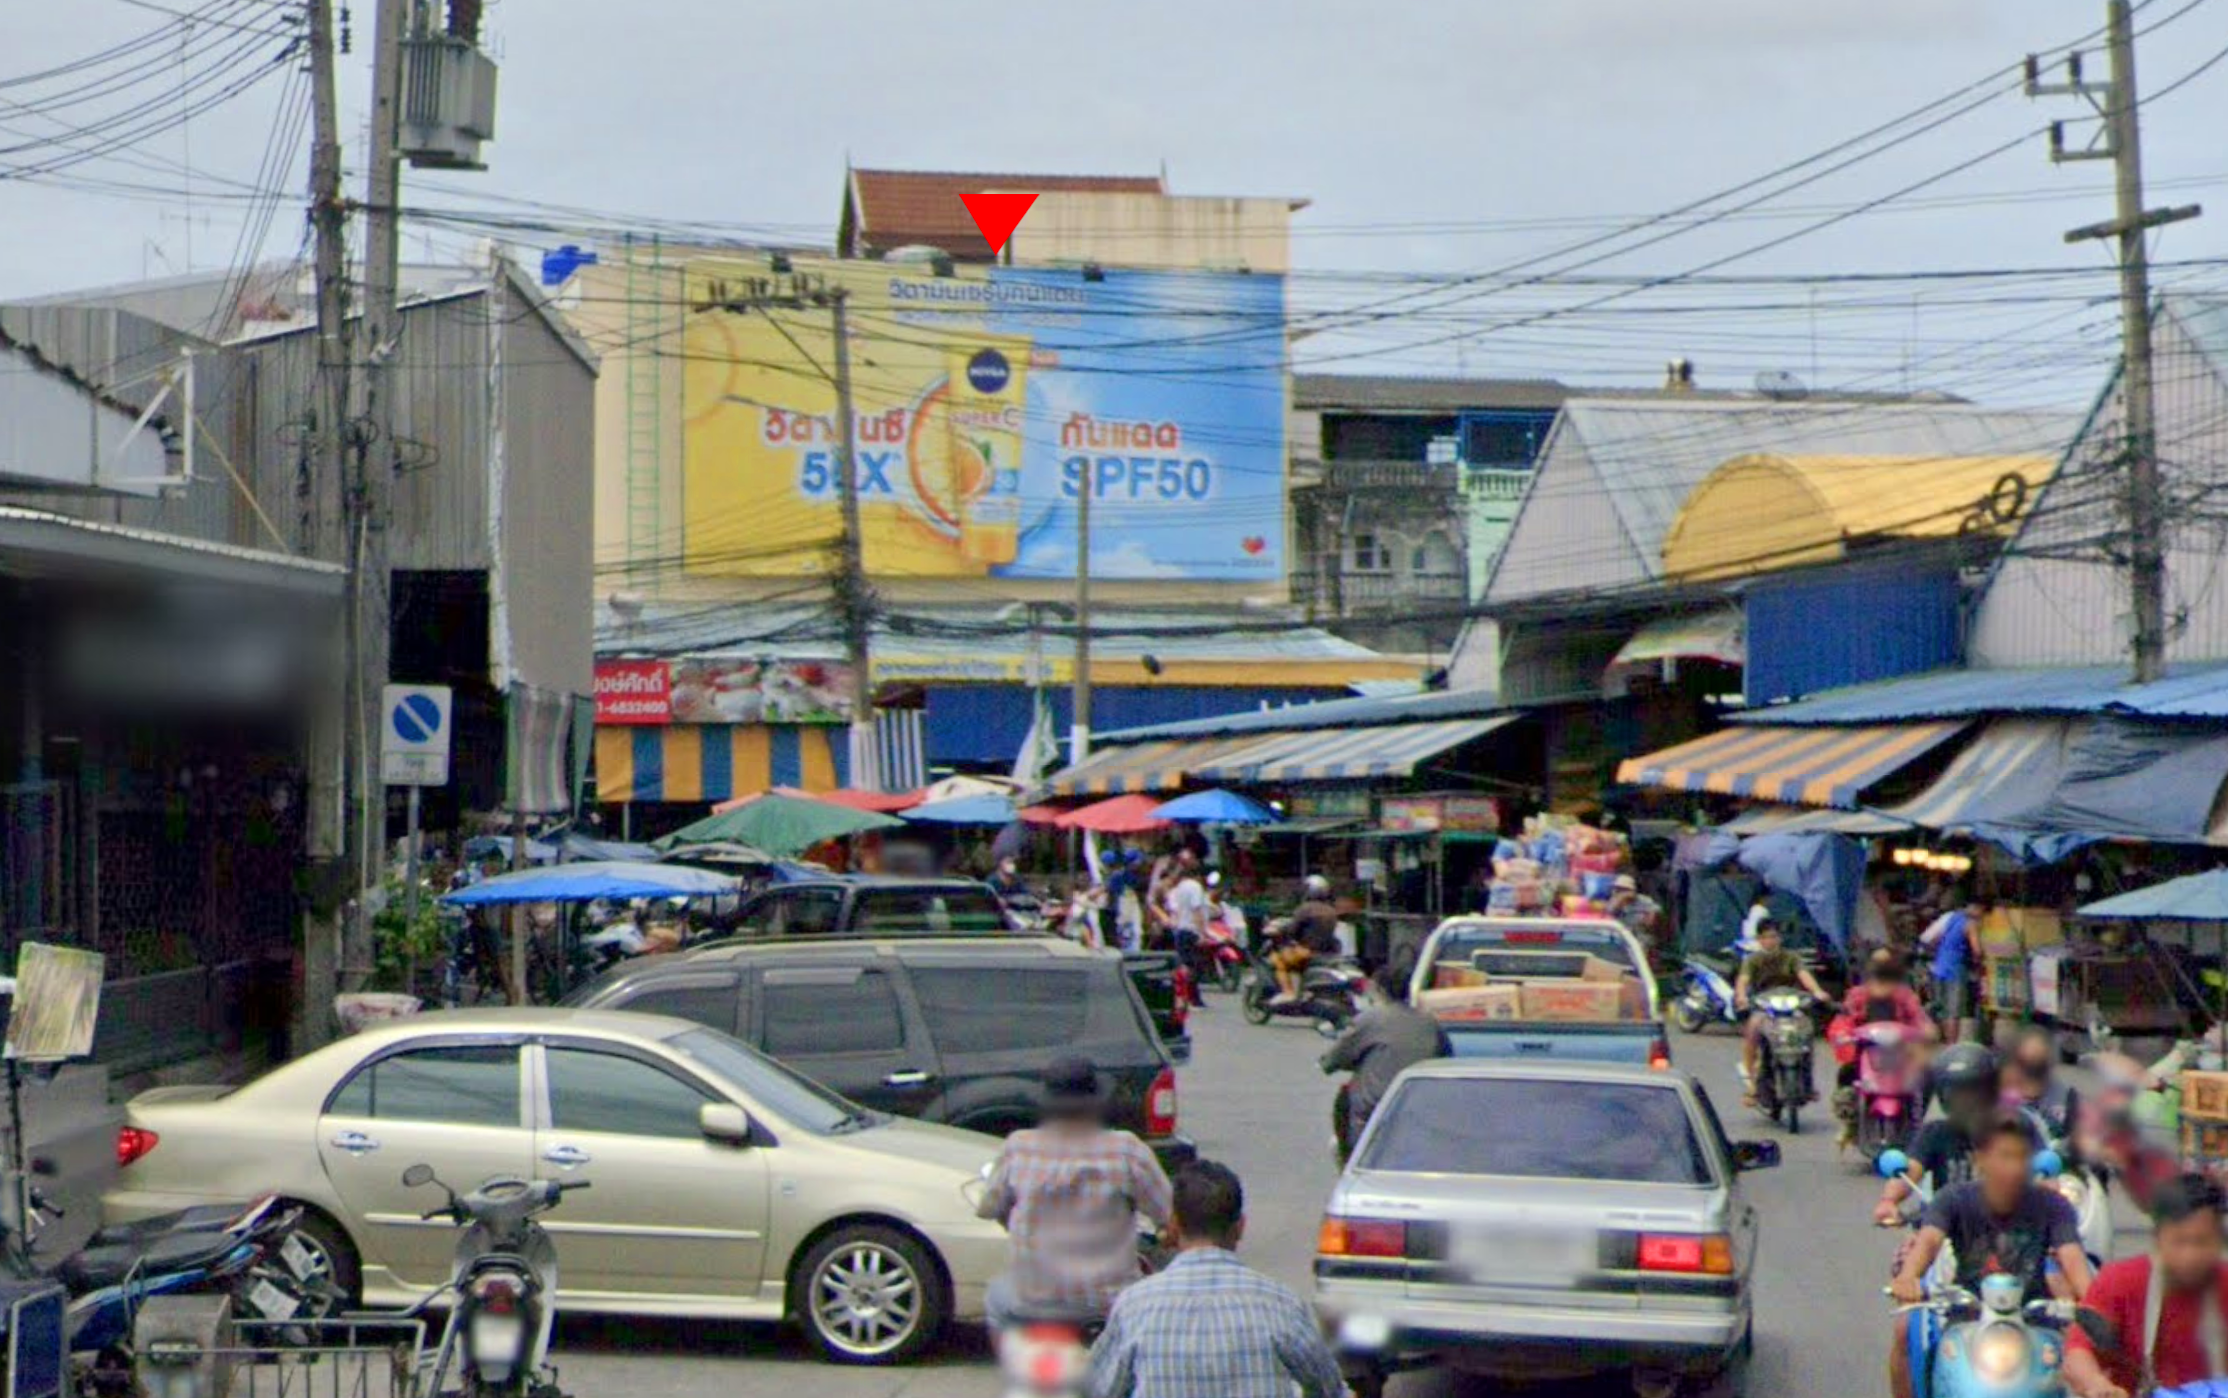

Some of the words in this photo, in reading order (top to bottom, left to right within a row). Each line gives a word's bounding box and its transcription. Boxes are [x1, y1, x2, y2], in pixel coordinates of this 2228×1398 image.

[765, 408, 906, 442] วิตานซี
[1061, 411, 1178, 449] กันแดด
[1061, 456, 1211, 499] SPF50
